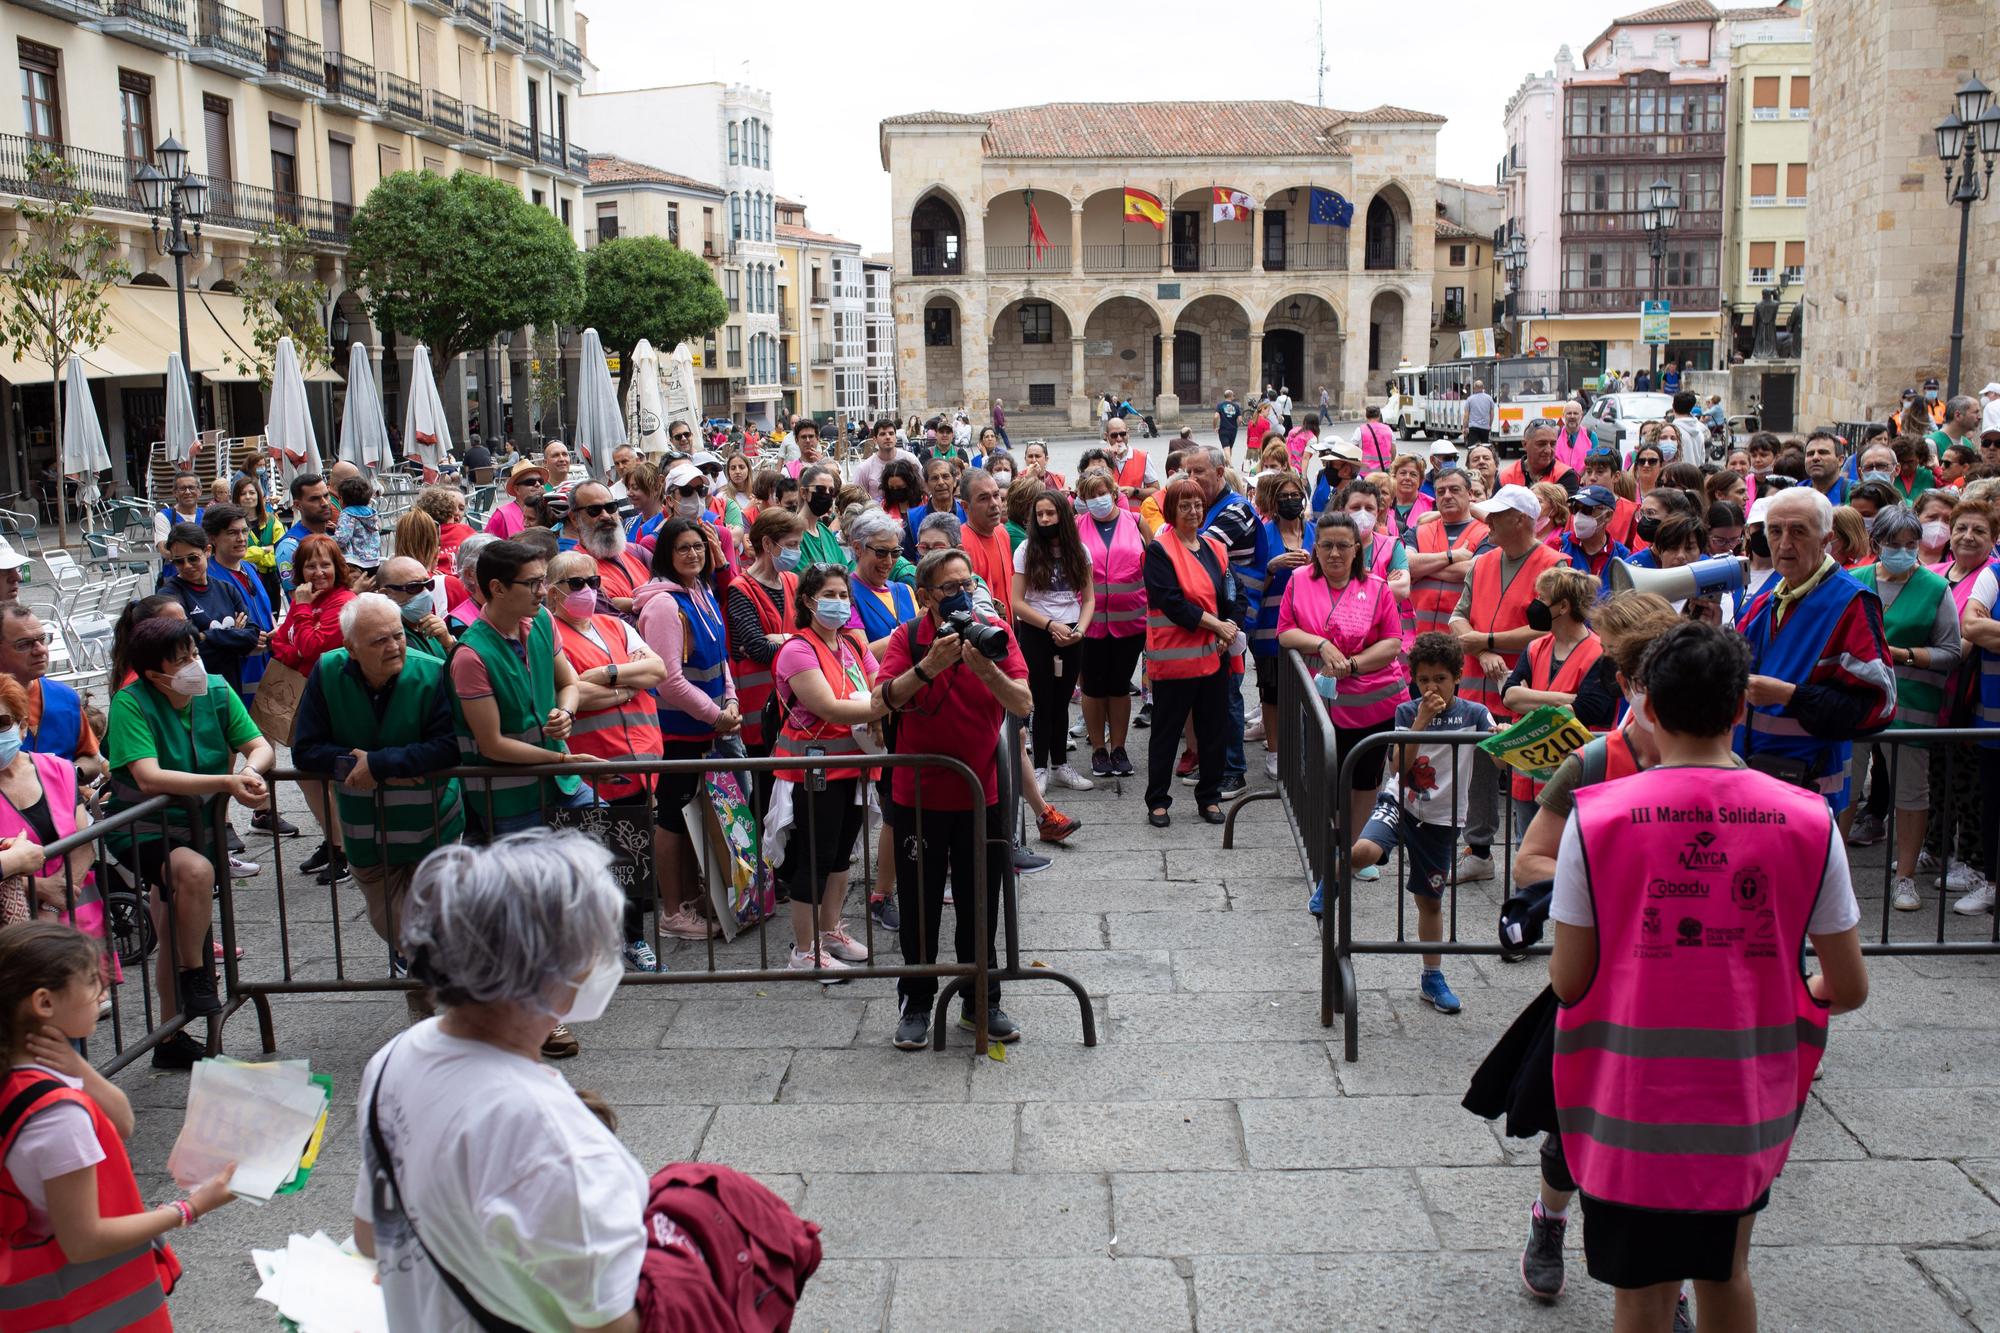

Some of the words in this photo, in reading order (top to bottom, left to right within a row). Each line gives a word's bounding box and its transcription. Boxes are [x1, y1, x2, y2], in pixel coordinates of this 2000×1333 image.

[1528, 724, 1550, 738] CAJA
[1520, 727, 1585, 766] 0123
[1631, 807, 1651, 824] III
[1657, 806, 1714, 823] Marcha
[1719, 807, 1786, 825] Solidaria
[1678, 843, 1729, 870] AZAYCA
[1648, 878, 1710, 899] Cobadu
